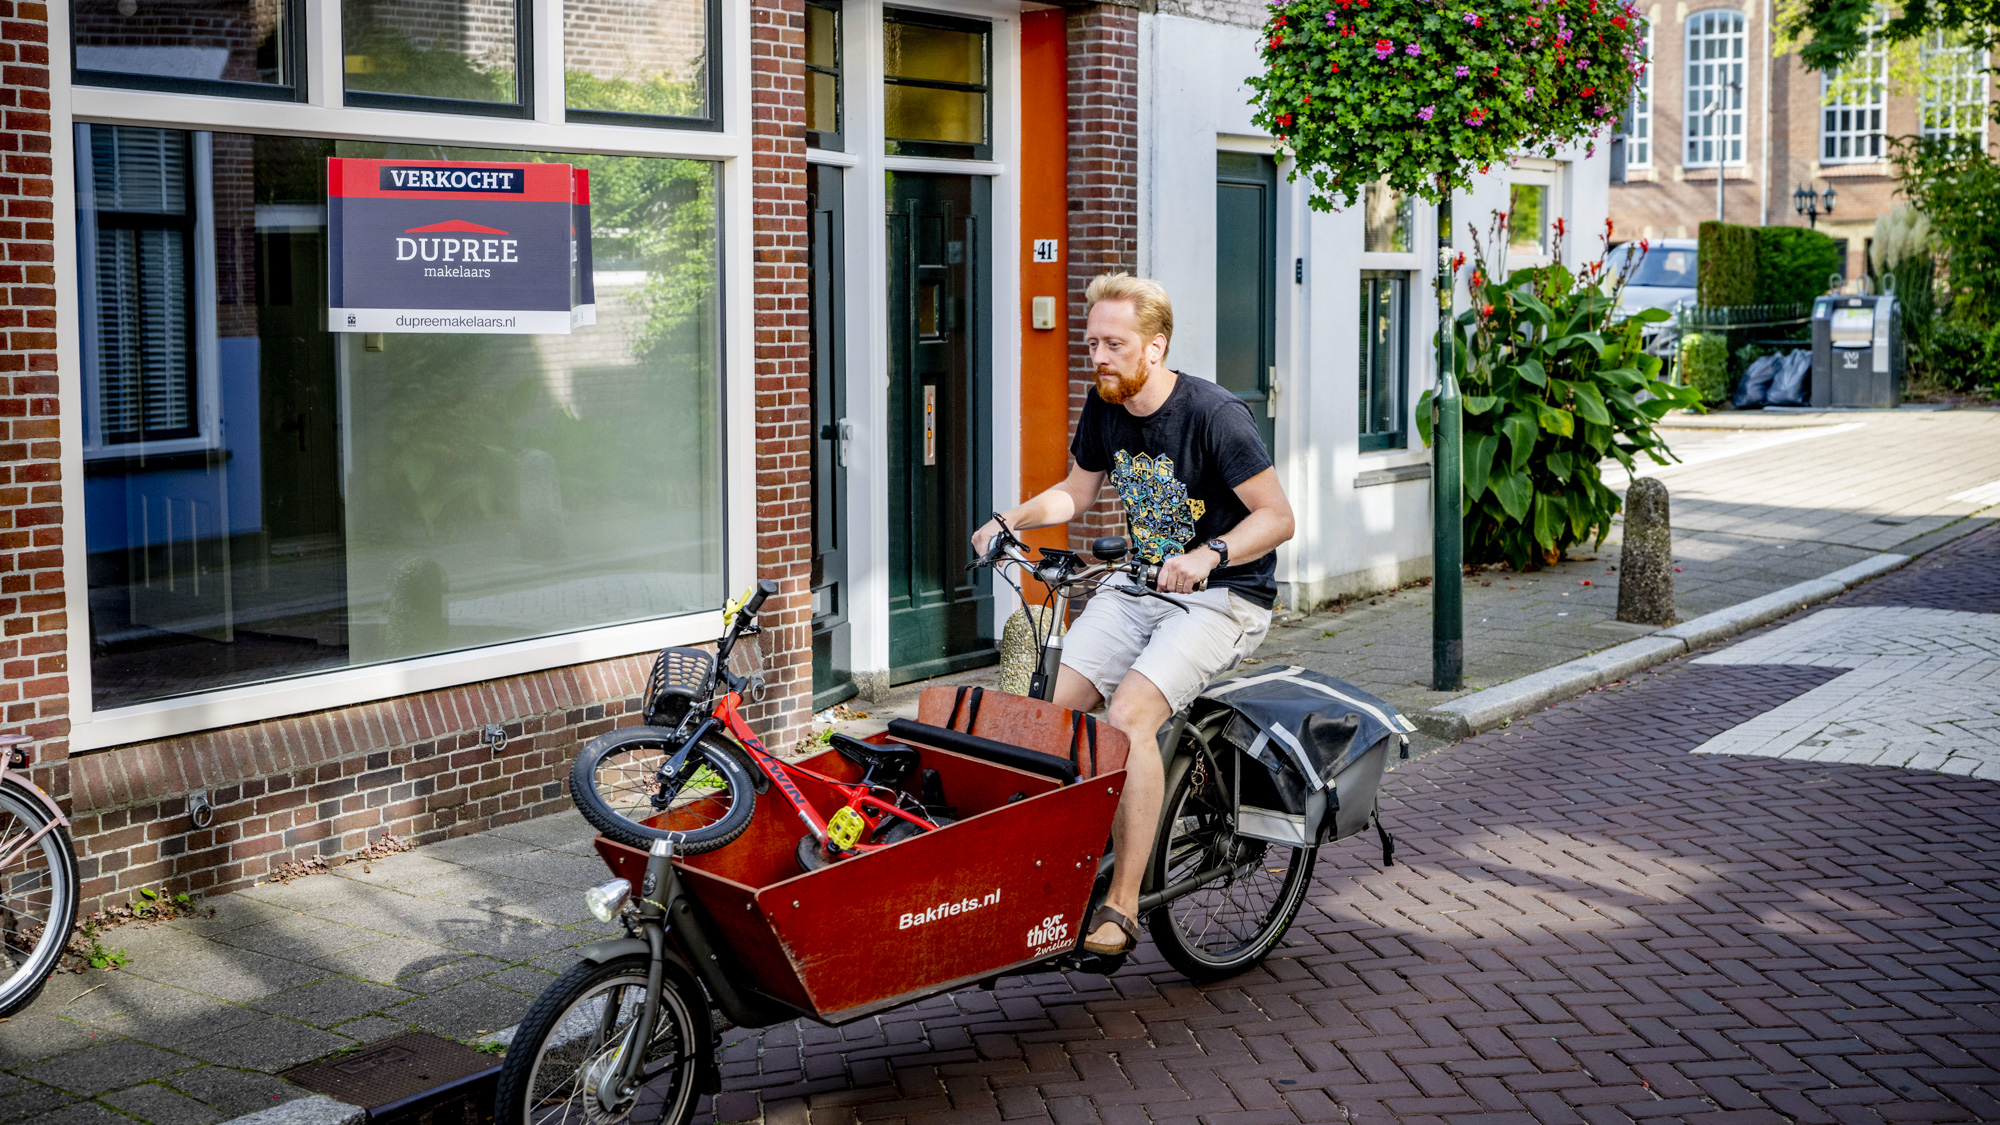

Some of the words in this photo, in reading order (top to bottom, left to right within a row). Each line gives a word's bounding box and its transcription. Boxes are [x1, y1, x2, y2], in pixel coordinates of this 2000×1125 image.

[391, 170, 514, 189] VERKOCHT
[396, 237, 518, 263] DUPREE
[1038, 242, 1052, 260] 41
[424, 265, 491, 278] makelaars
[396, 314, 516, 328] dupreemakelaars.nl
[899, 888, 1001, 930] Bakfiets.nl
[1027, 923, 1068, 948] thiers
[1034, 938, 1074, 957] 2wielers
